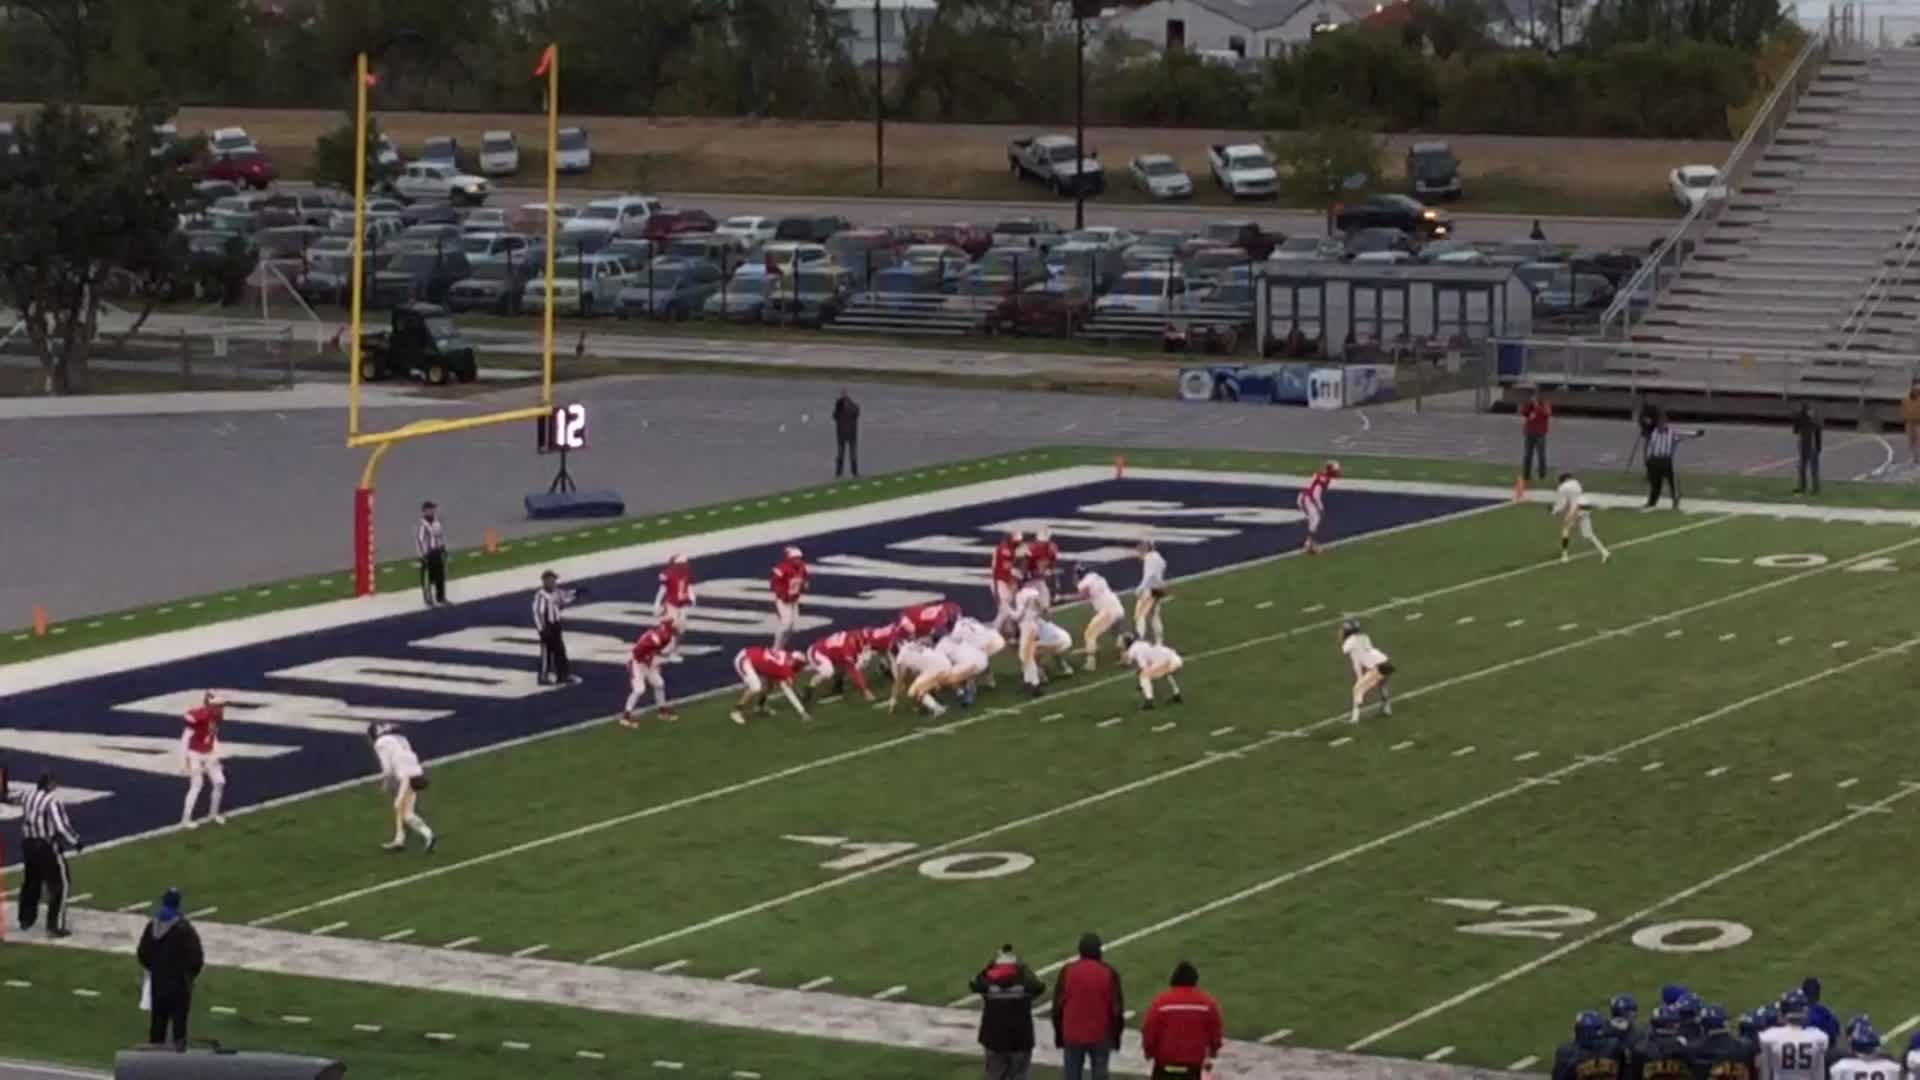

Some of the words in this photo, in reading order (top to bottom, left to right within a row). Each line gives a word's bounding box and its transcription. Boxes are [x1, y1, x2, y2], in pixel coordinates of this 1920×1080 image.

[556, 403, 585, 448] 12
[818, 841, 1035, 880] 10
[1455, 905, 1753, 952] 20
[1781, 1043, 1814, 1070] 85
